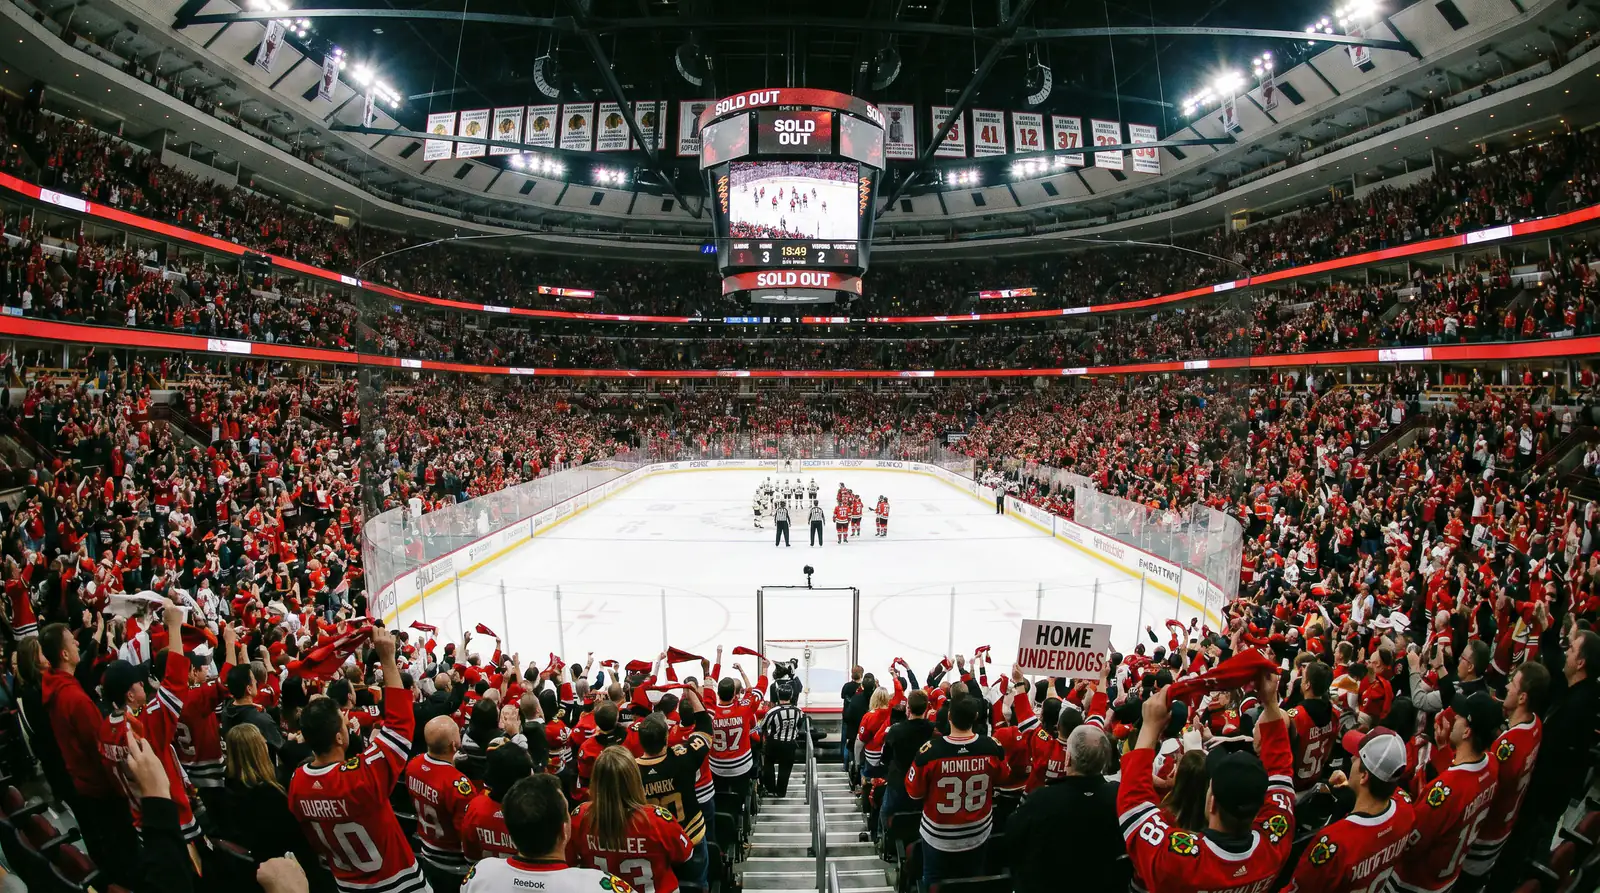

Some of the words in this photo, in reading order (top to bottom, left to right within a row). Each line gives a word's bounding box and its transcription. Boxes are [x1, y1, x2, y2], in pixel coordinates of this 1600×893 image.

[715, 95, 745, 116] SOLD
[749, 90, 780, 106] OUT
[774, 120, 815, 132] SOLD
[981, 125, 998, 143] 41
[779, 133, 811, 145] OUT
[1020, 128, 1038, 146] 12
[762, 251, 770, 263] 3
[817, 251, 825, 263] 2
[781, 246, 807, 256] 18:49
[757, 272, 797, 287] SOLD
[800, 272, 830, 287] OUT
[1036, 624, 1093, 649] HOME
[1018, 647, 1105, 672] UNDERDOGS
[713, 726, 743, 752] 97
[936, 773, 990, 814] 38
[310, 820, 384, 873] 10
[513, 877, 545, 890] Reebok
